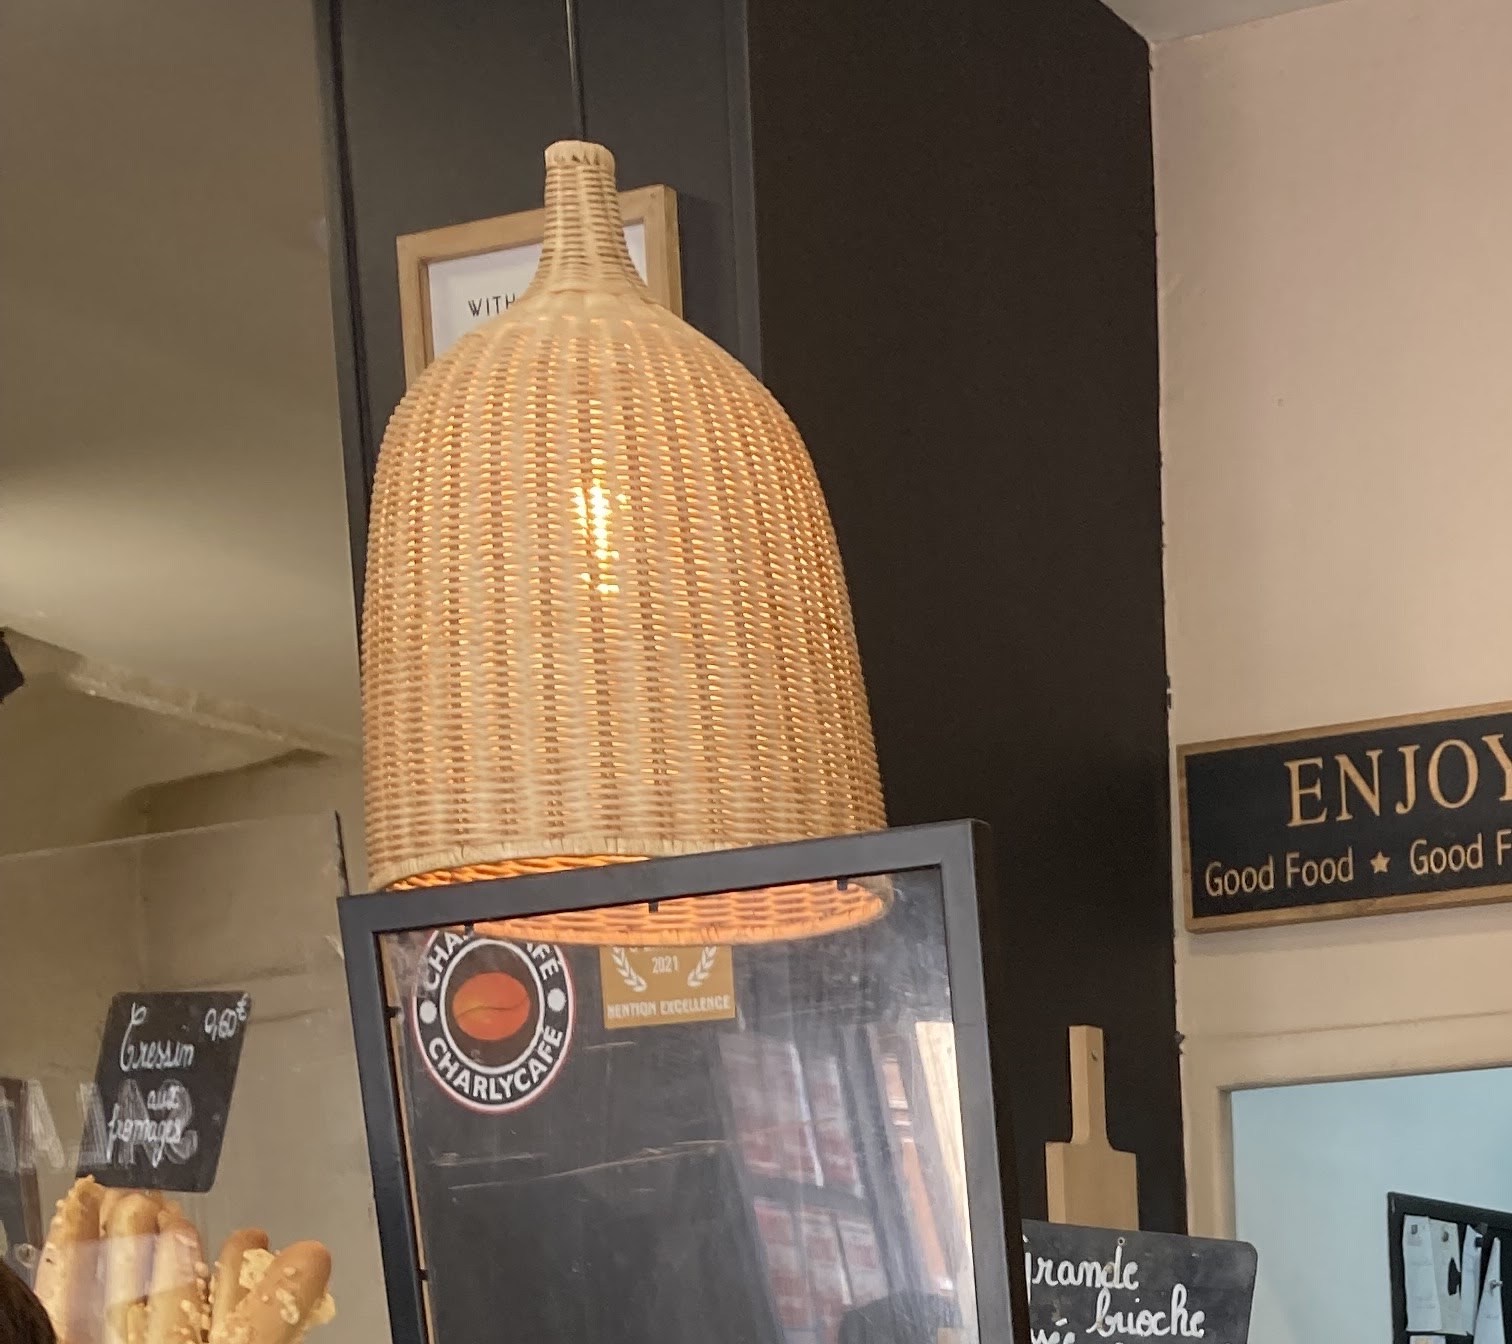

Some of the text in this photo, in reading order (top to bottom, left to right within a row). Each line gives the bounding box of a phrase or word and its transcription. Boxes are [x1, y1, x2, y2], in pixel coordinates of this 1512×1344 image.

[467, 292, 516, 317] WITH
[1205, 859, 1275, 898] Good
[1285, 846, 1355, 889] Food
[1408, 838, 1484, 876] Good
[651, 955, 679, 974] 2021
[660, 995, 731, 1015] EXCELLENCE
[427, 1023, 565, 1101] CHARLYCAFE
[1086, 1284, 1206, 1338] brioche
